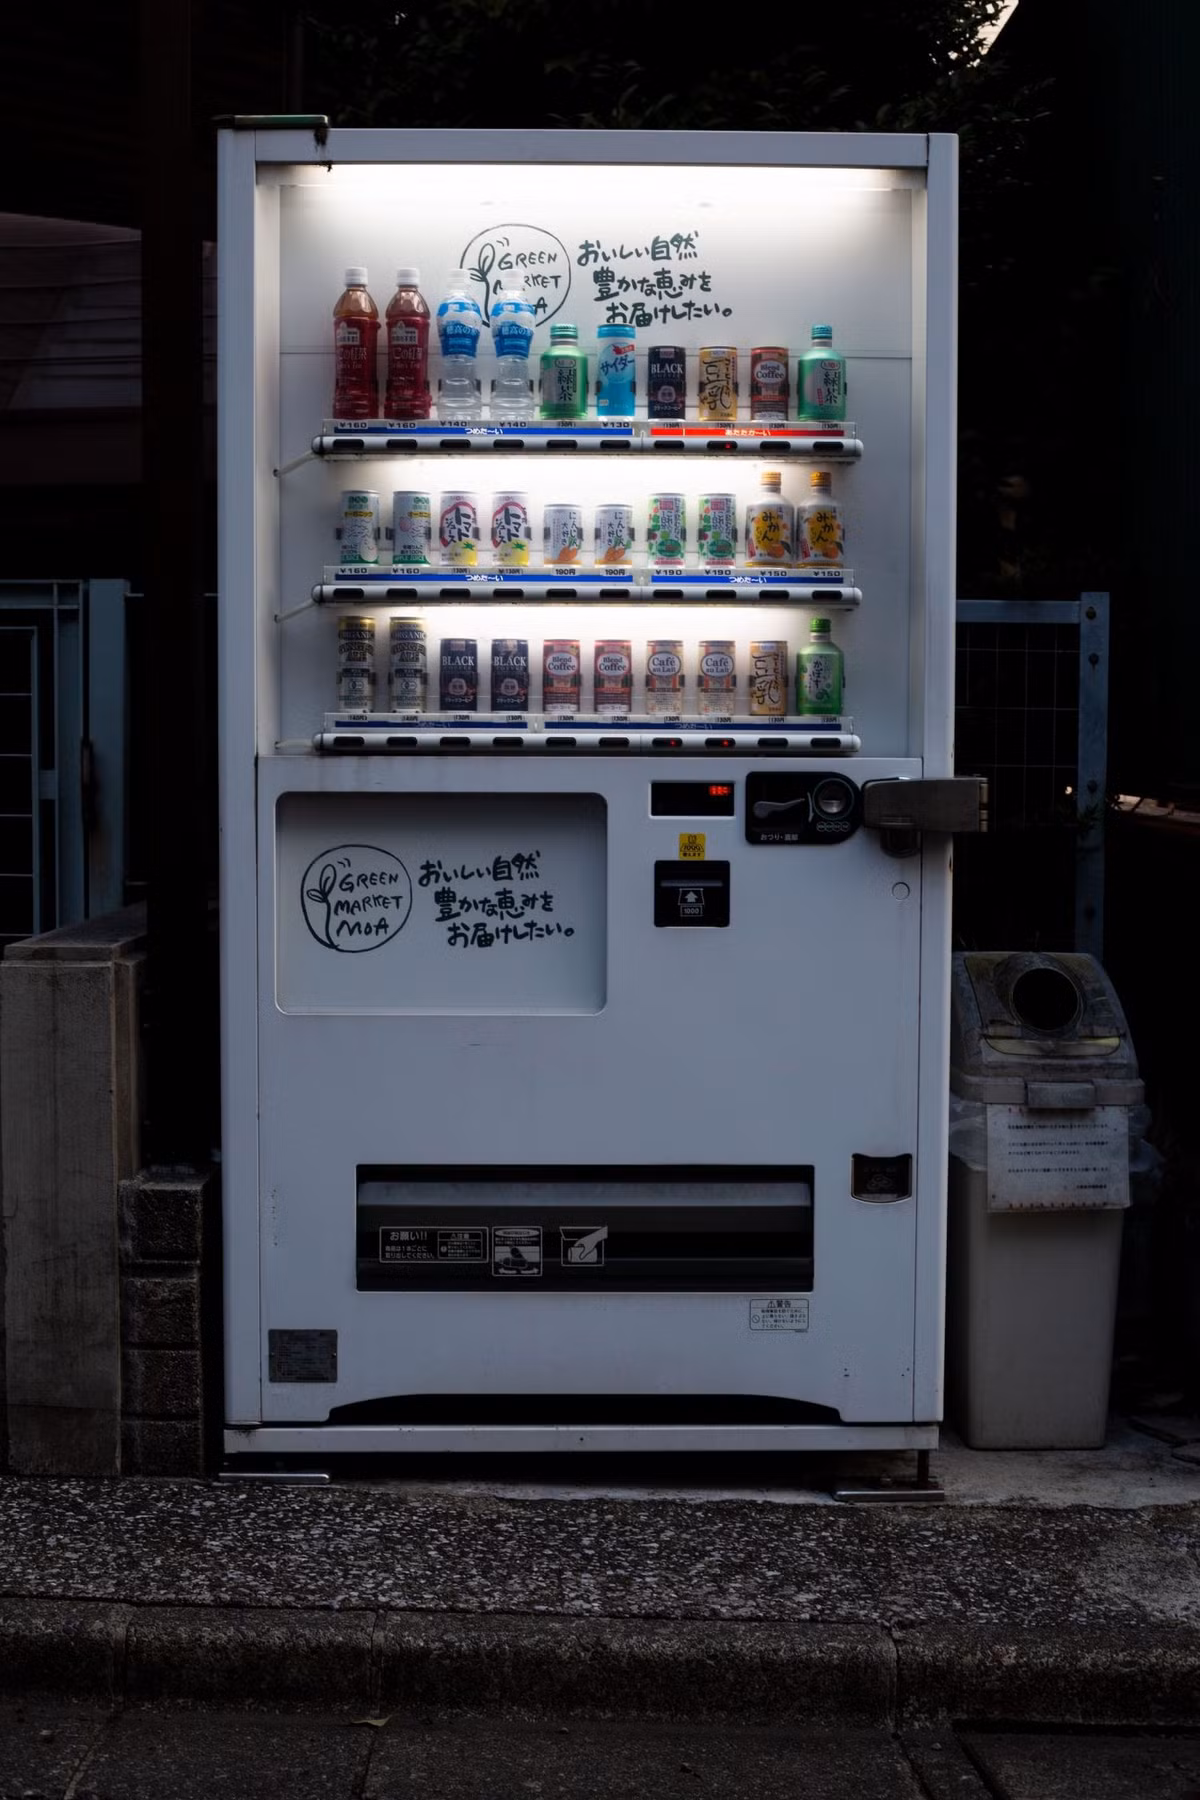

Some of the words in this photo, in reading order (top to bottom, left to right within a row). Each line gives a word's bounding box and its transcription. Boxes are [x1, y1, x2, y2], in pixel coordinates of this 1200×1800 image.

[577, 230, 699, 266] おいしい自然
[498, 253, 557, 270] GREEN
[593, 267, 712, 301] 豊かな恵みを
[606, 301, 733, 327] お届けしたい。
[600, 354, 636, 376] サイダー
[651, 363, 684, 374] BLACK
[756, 371, 785, 379] Coffee
[569, 512, 579, 547] にんじん
[615, 512, 625, 547] にんじん
[762, 511, 780, 542] みかん
[816, 511, 834, 542] みかん
[442, 656, 475, 666] BLACK
[494, 656, 526, 667] BLACK
[548, 663, 576, 671] Coffee
[599, 663, 627, 672] Coffee
[652, 656, 675, 667] Café
[705, 657, 729, 668] Café
[418, 850, 541, 887] おいしい自然
[339, 872, 399, 893] GREEN
[333, 894, 403, 916] MARKET
[434, 886, 554, 922] 豊かな恵みを
[336, 917, 389, 937] MOA
[447, 920, 574, 948] お届けしたい。
